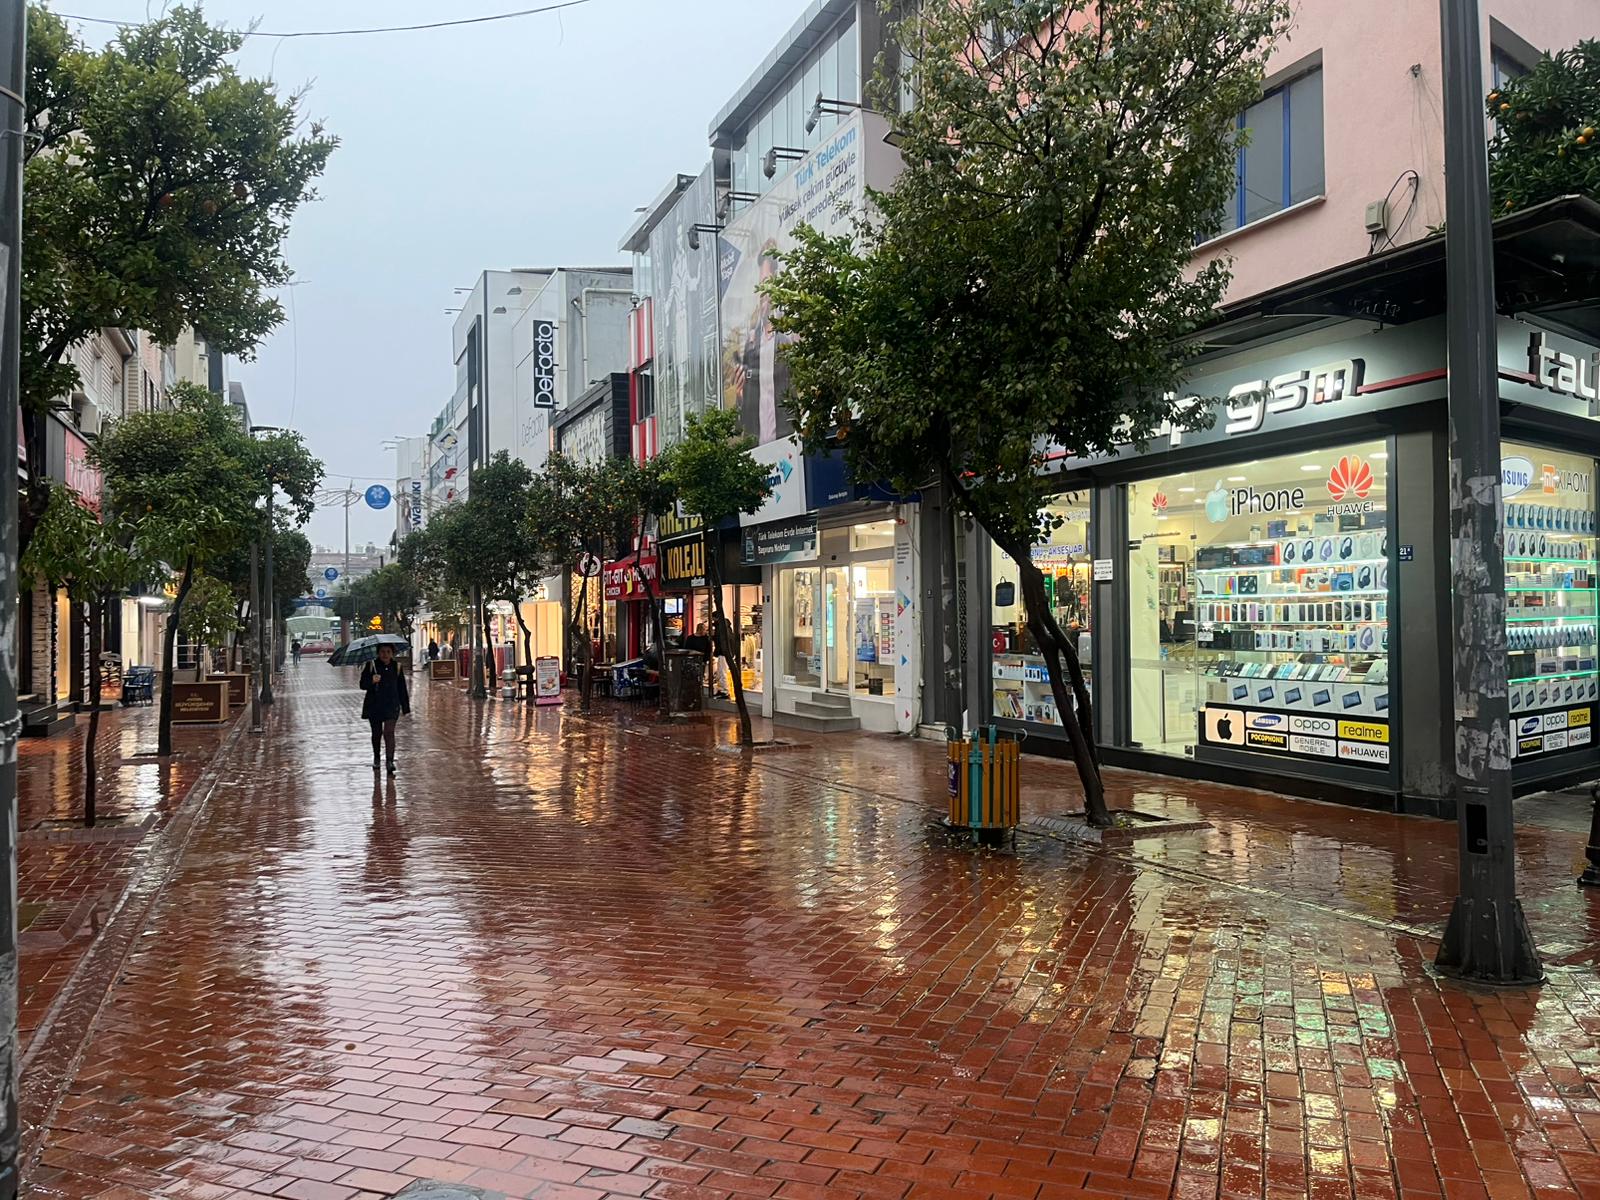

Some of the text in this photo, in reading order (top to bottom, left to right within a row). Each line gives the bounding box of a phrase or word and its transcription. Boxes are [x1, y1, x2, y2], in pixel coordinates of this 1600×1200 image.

[794, 127, 856, 189] Türk Telekom
[802, 181, 824, 208] çekim
[826, 152, 856, 189] gücüyle
[534, 323, 553, 406] DeFacto
[1226, 358, 1366, 434] gsm
[1557, 470, 1589, 493] XIAOMI
[1231, 486, 1304, 516] iPhone
[1327, 501, 1374, 516] HUAWEI
[1048, 544, 1083, 555] AKSESUAR
[1250, 733, 1284, 744] POCOPHONE
[1294, 736, 1331, 747] GENERAL
[1343, 725, 1383, 739] realme
[1350, 747, 1388, 759] HUAWEI
